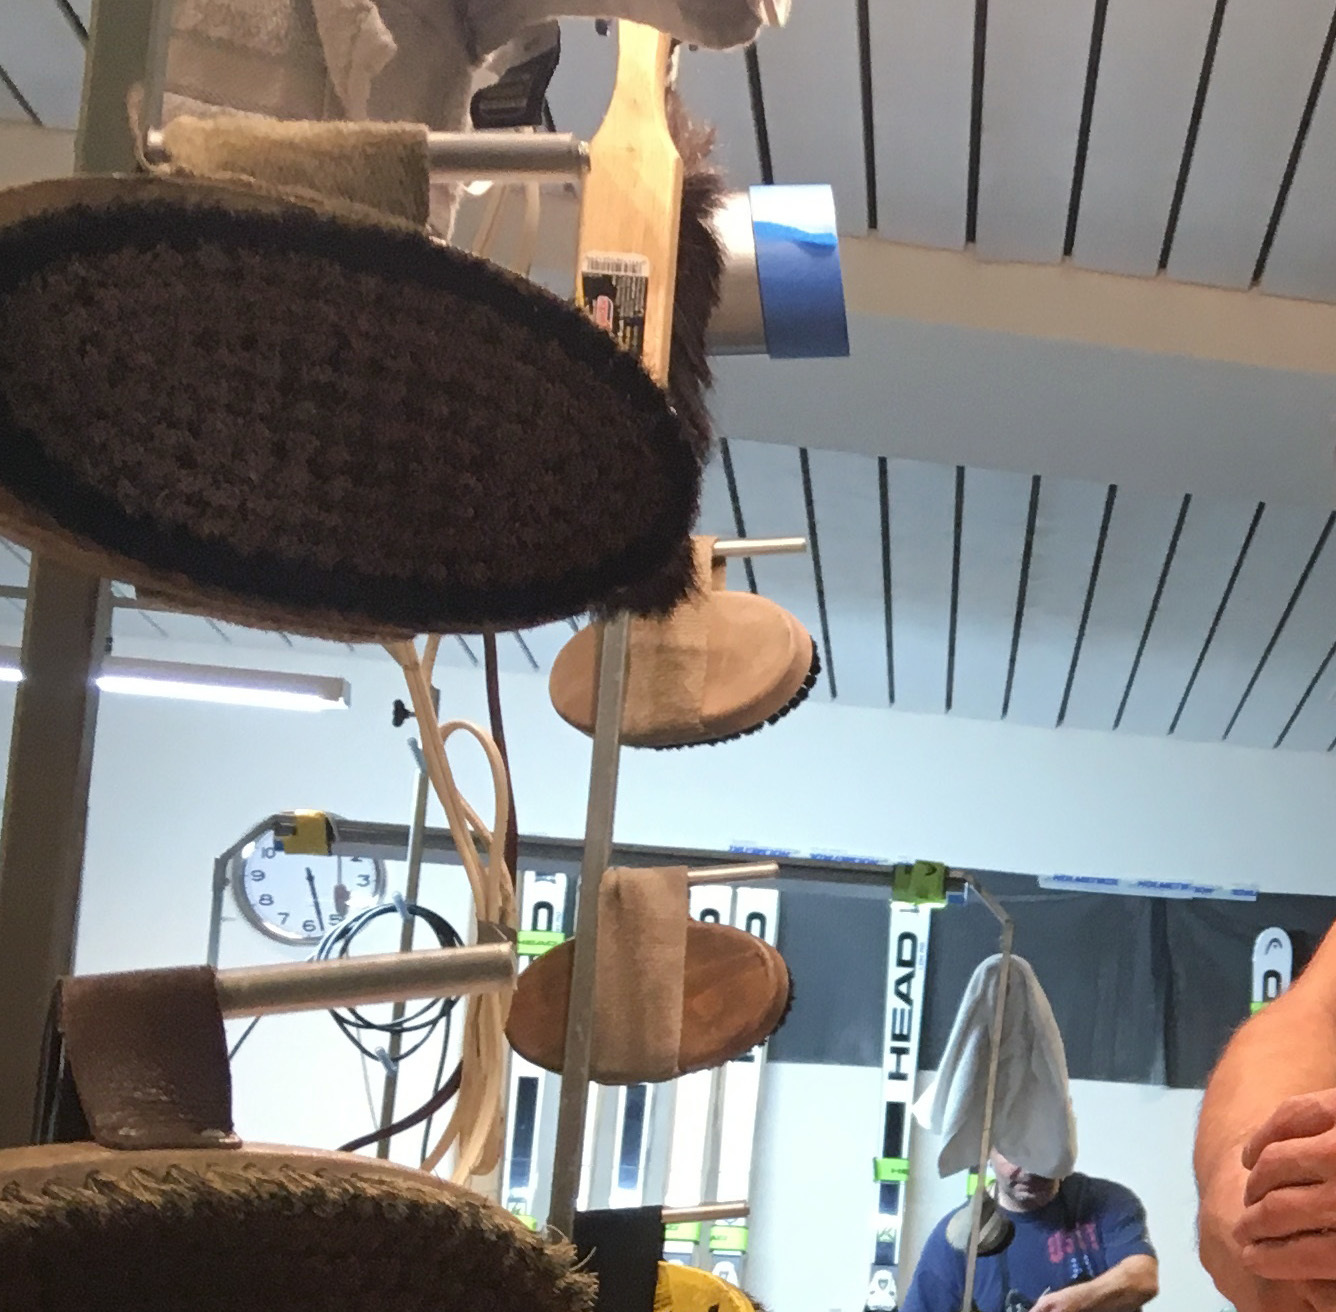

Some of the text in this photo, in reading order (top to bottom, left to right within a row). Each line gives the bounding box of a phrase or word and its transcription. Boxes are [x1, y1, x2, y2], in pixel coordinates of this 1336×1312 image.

[261, 847, 277, 859] 10
[250, 869, 266, 882] 9
[356, 874, 370, 887] 3
[258, 893, 274, 906] 8
[277, 912, 290, 925] 7
[302, 919, 316, 932] 6
[888, 930, 919, 1081] HEAD
